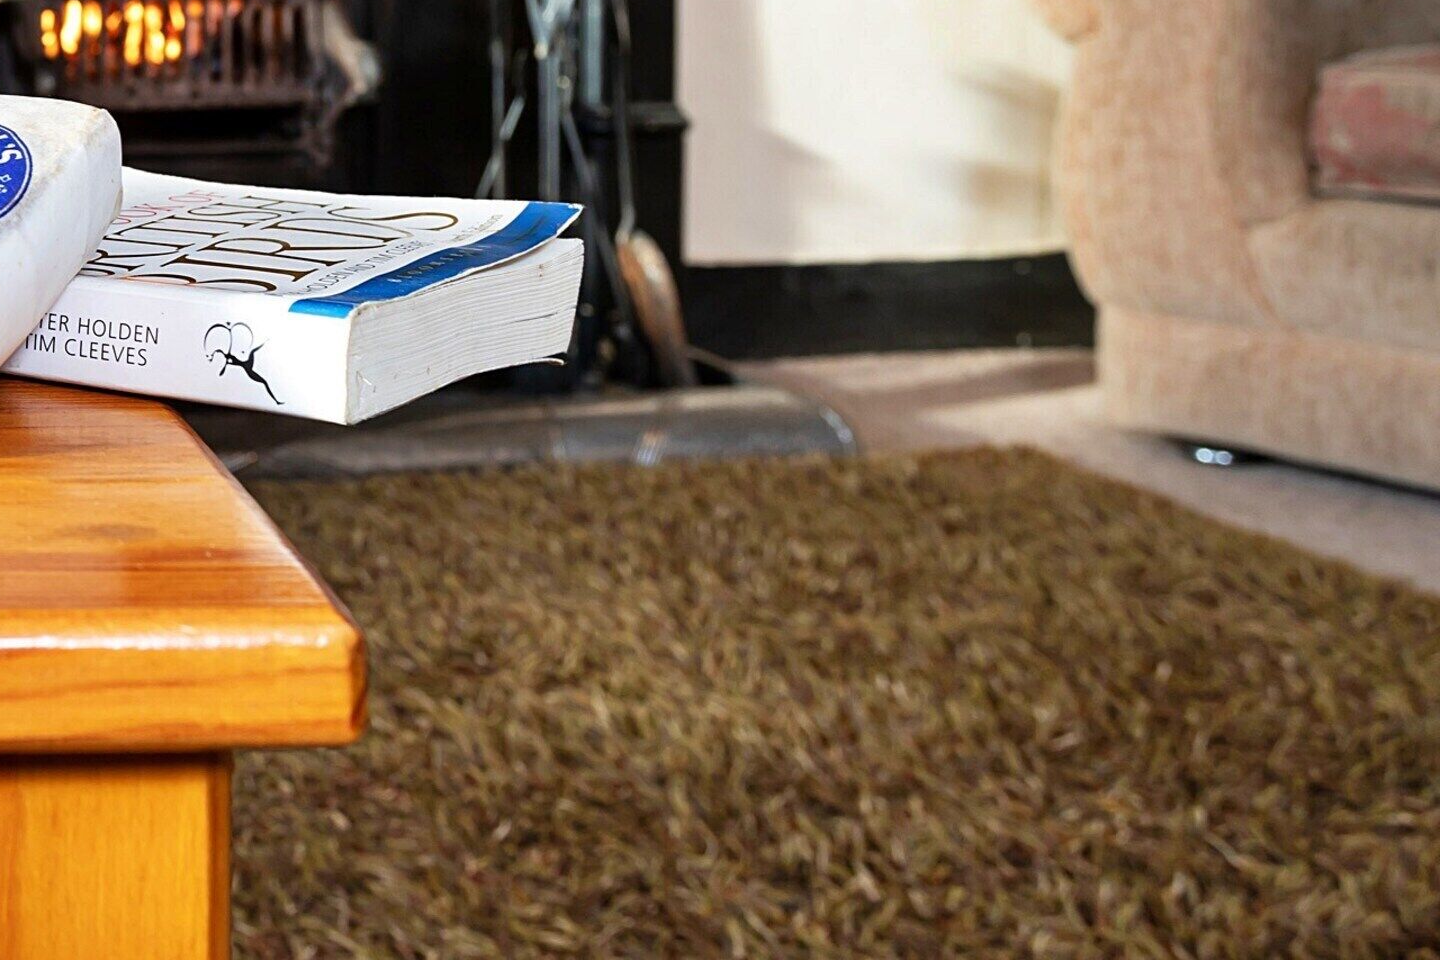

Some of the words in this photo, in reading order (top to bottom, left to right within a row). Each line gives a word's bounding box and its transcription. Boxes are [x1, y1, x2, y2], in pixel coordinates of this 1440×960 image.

[78, 317, 159, 345] HOLDEN
[25, 332, 56, 354] TIM
[64, 338, 148, 367] CLEEVES
